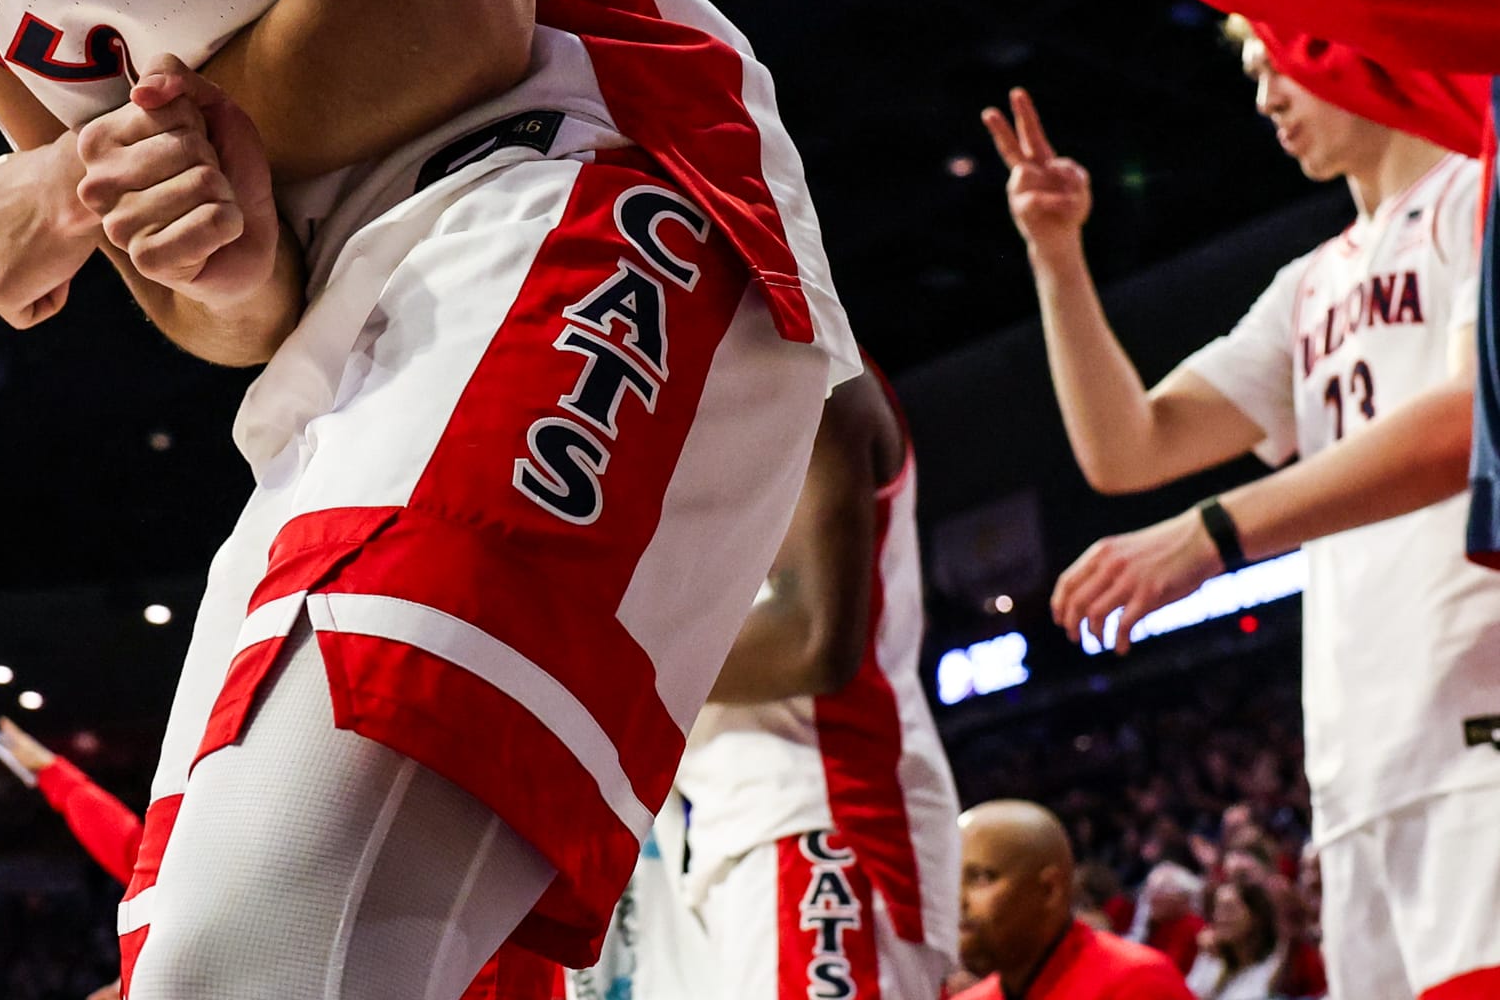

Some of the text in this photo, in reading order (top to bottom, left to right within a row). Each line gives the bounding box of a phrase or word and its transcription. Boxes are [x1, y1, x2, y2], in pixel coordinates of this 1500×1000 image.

[513, 119, 544, 135] 46
[512, 185, 711, 525] CATS
[799, 830, 861, 1000] CATS
